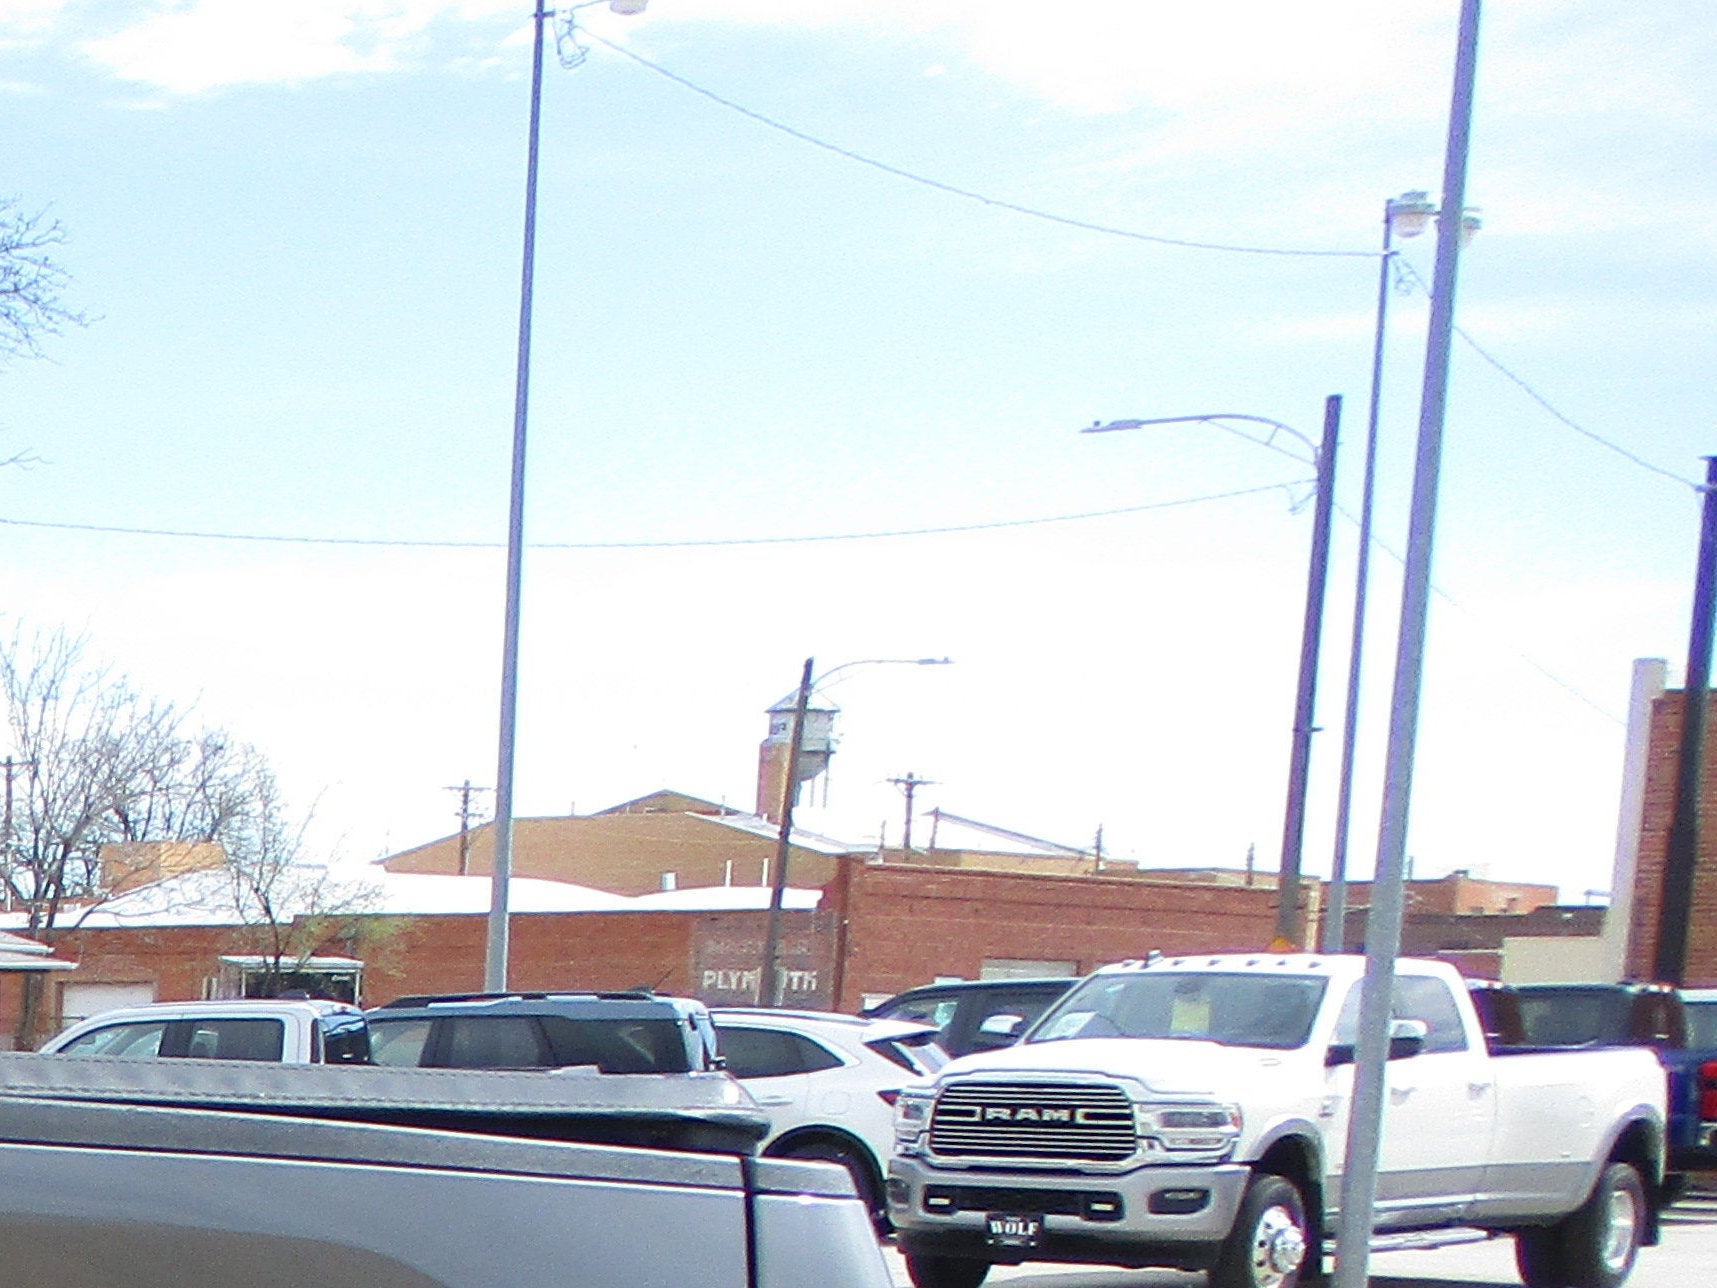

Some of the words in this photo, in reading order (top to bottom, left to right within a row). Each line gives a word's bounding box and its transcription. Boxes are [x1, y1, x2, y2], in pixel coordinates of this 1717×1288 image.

[702, 967, 817, 991] PLYMTH
[985, 1108, 1070, 1121] RAM
[990, 1221, 1039, 1235] WOLF
